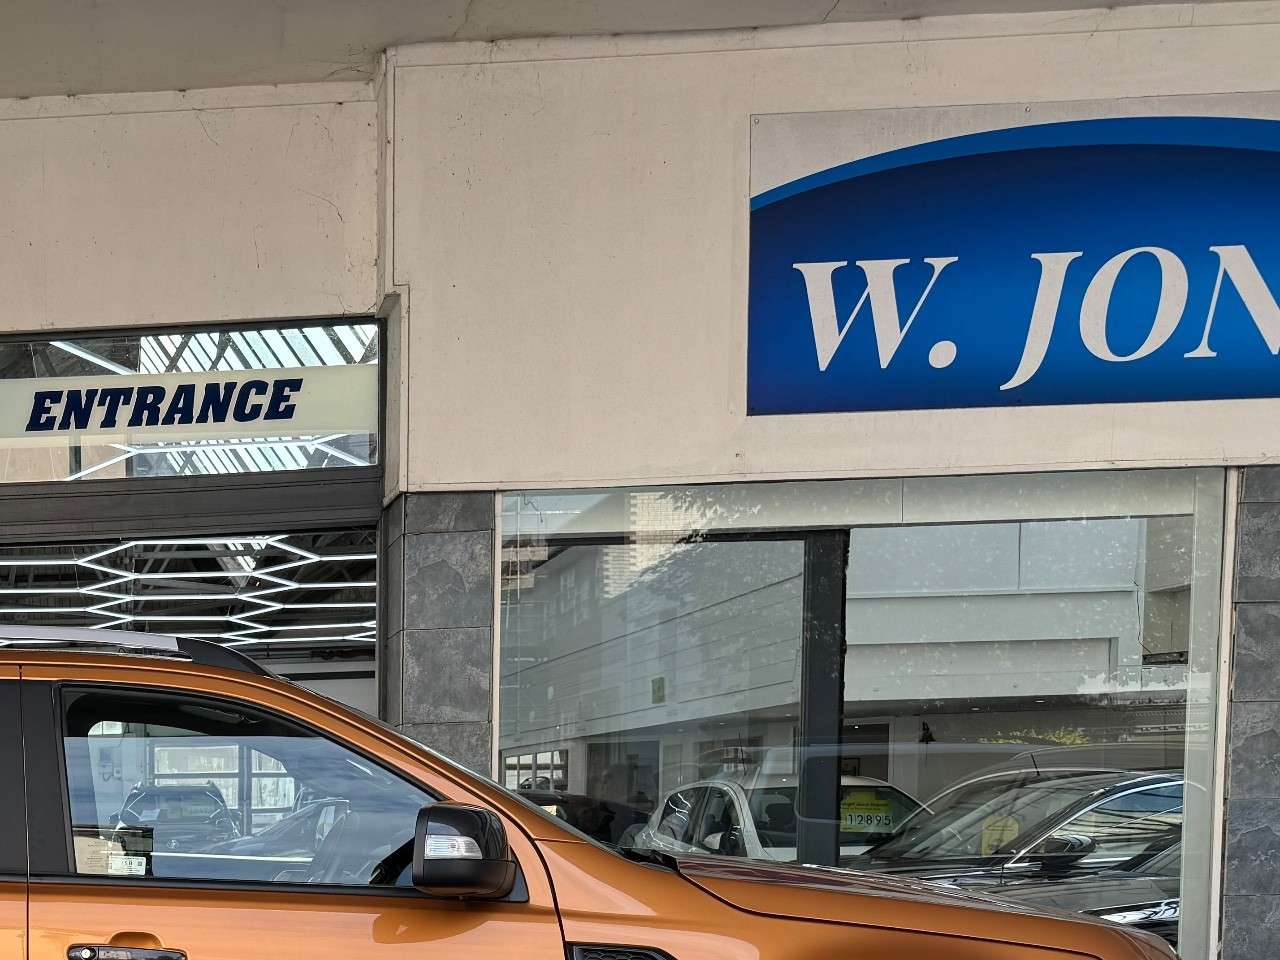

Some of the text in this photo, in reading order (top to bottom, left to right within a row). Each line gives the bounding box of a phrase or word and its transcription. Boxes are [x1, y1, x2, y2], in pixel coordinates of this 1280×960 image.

[792, 256, 959, 372] W.
[25, 378, 304, 432] ENTRANCE
[848, 814, 891, 826] 12895
